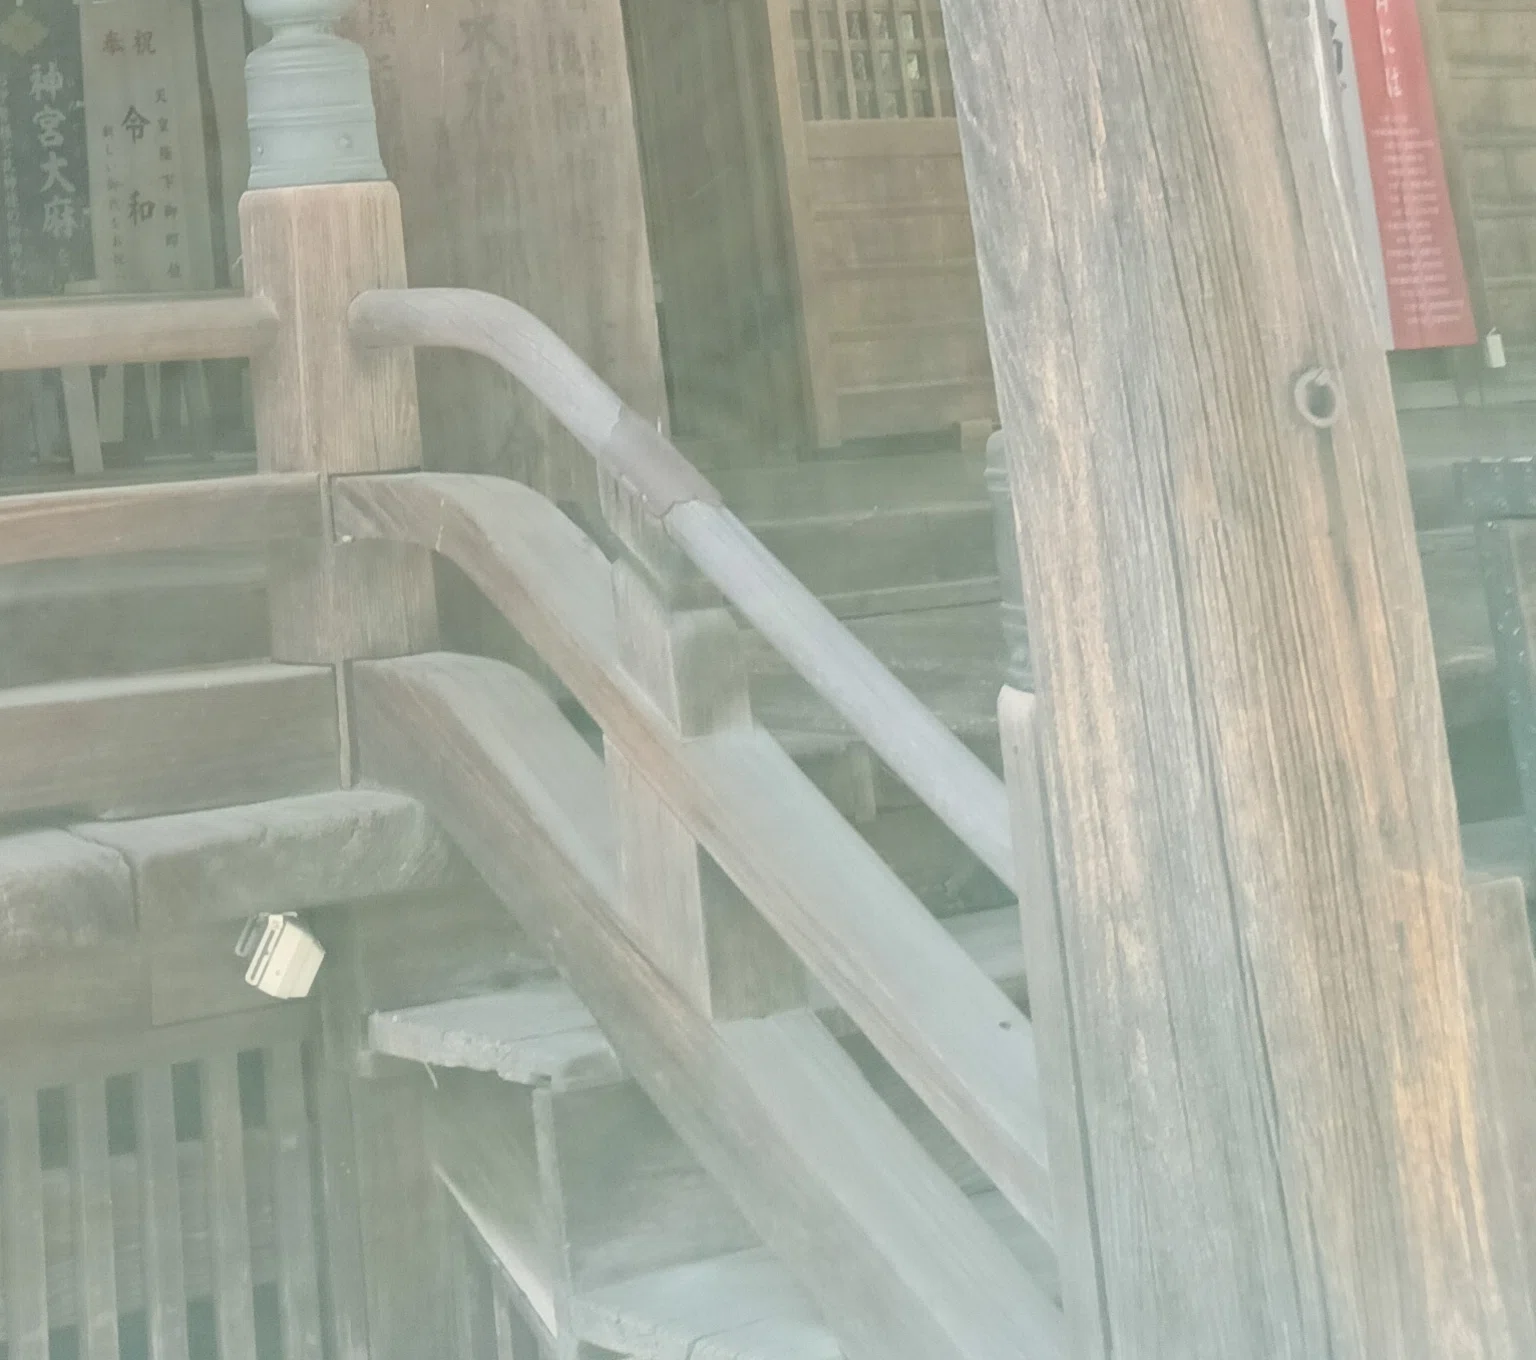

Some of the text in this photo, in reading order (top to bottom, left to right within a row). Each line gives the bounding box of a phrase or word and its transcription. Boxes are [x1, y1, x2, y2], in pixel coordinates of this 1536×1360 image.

[29, 58, 78, 241] 神宮大麻
[121, 104, 157, 228] 令和
